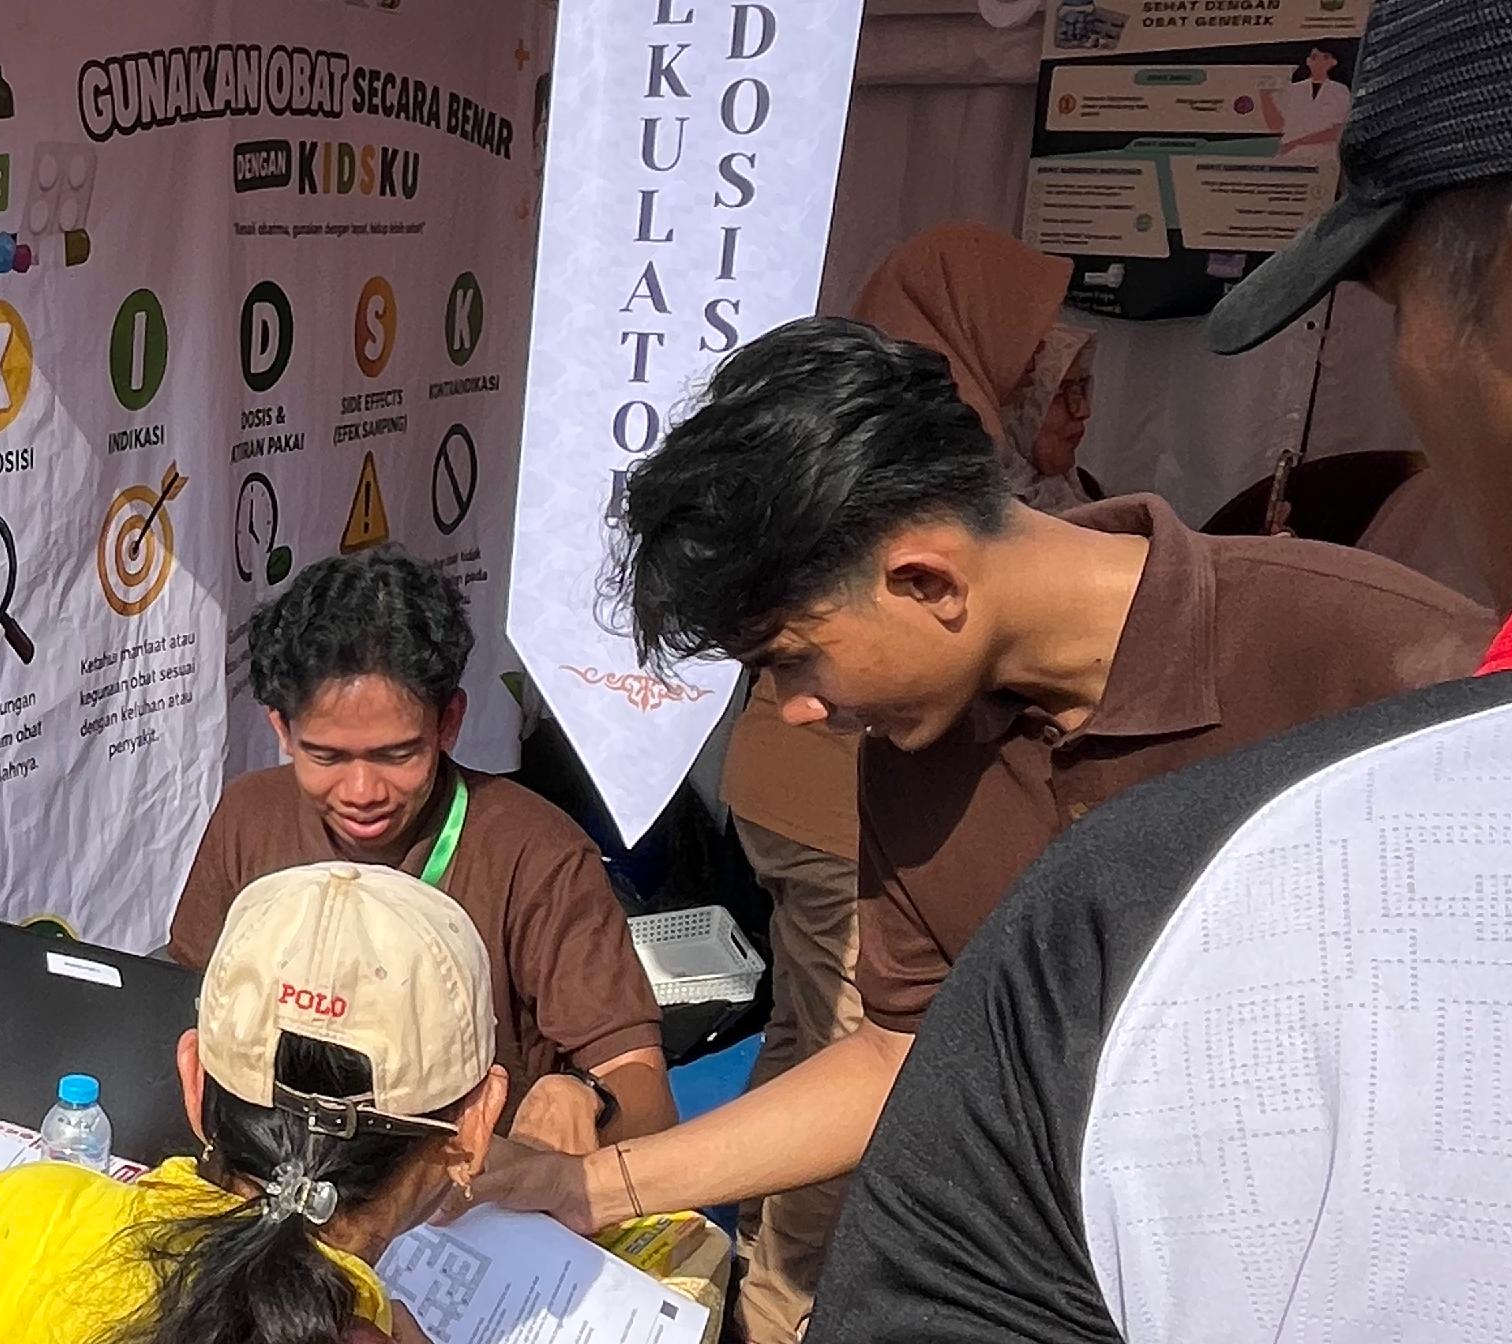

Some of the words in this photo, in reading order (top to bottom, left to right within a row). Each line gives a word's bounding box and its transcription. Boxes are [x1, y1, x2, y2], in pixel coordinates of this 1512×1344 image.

[1142, 0, 1199, 13] SEHAT
[1142, 16, 1188, 28] OBAT
[1194, 15, 1274, 27] GENERIK
[80, 45, 263, 140] GUNAKAN
[265, 45, 349, 117] OBAT
[352, 66, 441, 130] SECARA
[447, 92, 514, 159] BENAR
[236, 149, 287, 180] DENGAN
[298, 140, 420, 199] KIDSKU
[698, 4, 777, 353] DOSIS
[130, 311, 148, 391] I
[250, 301, 280, 374] D
[364, 294, 386, 361] S
[453, 288, 474, 350] K
[341, 394, 362, 415] SIDE
[364, 389, 404, 411] EFFECTS
[241, 407, 272, 430] DOSIS
[276, 405, 286, 424] &
[108, 424, 165, 454] INDIKASI
[267, 433, 305, 455] PAKAI
[120, 637, 167, 662] manfaat
[170, 632, 196, 650] atau
[130, 670, 156, 689] obat
[159, 657, 196, 682] sesuai
[80, 711, 118, 738] dengan
[120, 699, 166, 722] keluhan
[168, 692, 193, 708] atau
[16, 721, 42, 742] obat
[278, 982, 347, 1018] POLO
